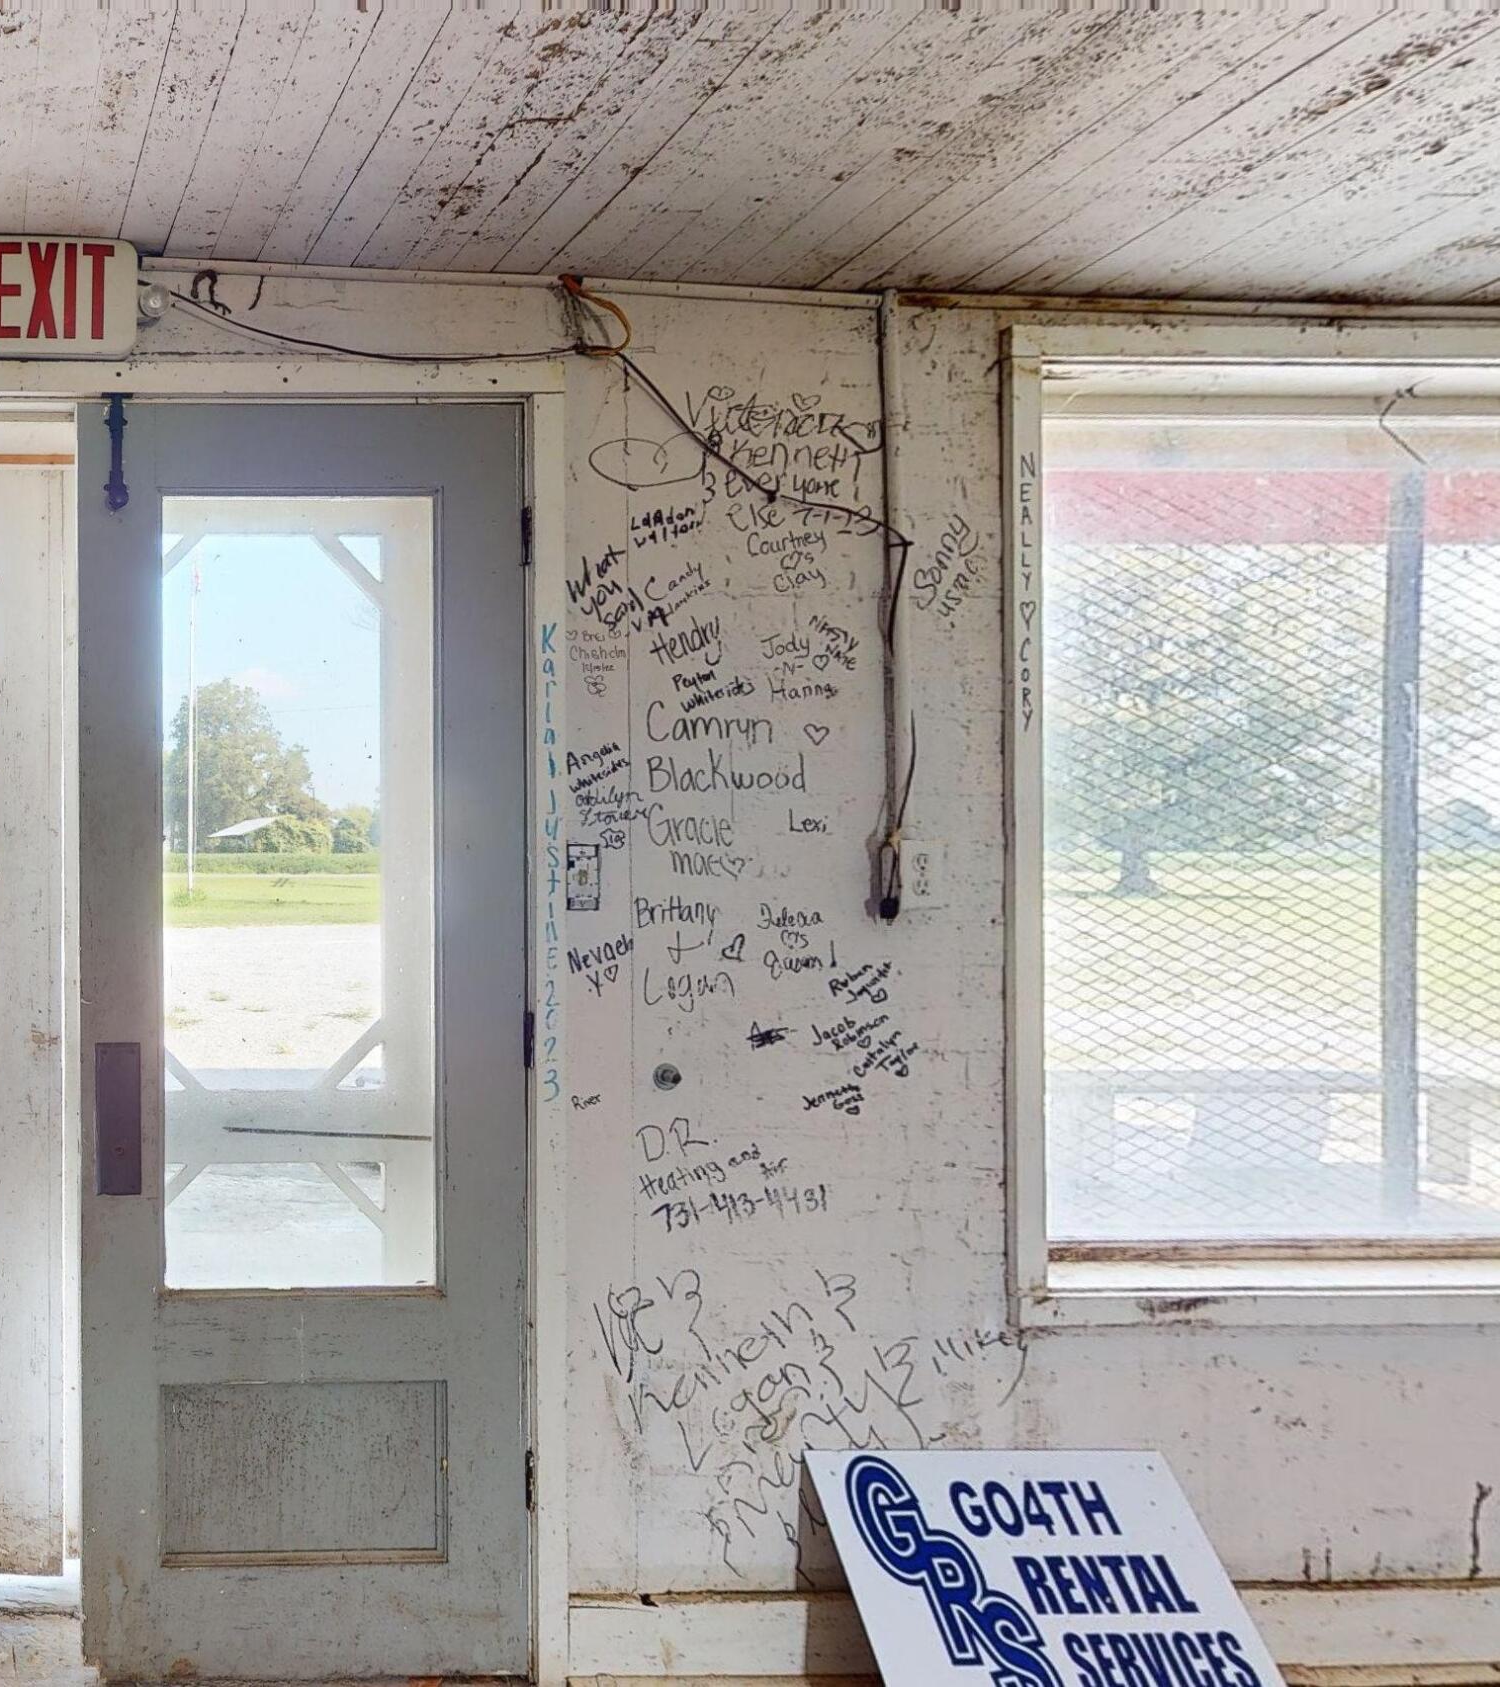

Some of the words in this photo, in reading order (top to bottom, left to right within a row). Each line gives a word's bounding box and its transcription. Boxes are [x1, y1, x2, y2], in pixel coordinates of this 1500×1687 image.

[746, 529, 828, 558] Courtney
[1018, 452, 1037, 592] NEALLY
[644, 562, 705, 602] Candy
[773, 568, 827, 593] Clay
[913, 513, 980, 611] Sonny
[760, 632, 810, 660] Jody
[1018, 637, 1034, 733] CORY
[647, 700, 773, 745] Camryn
[646, 747, 806, 793] Blackwood
[649, 802, 734, 848] Gracie
[788, 808, 830, 834] Lexi
[634, 895, 717, 938] Brittany
[566, 933, 635, 975] Nevaeh
[811, 1016, 857, 1046] Jacob
[639, 1161, 727, 1200] Heating
[651, 1184, 828, 1233] 731-413-4431
[948, 1480, 1122, 1538] GO4TH
[1012, 1555, 1199, 1615] RENTAL
[1062, 1631, 1260, 1687] SERVICES
